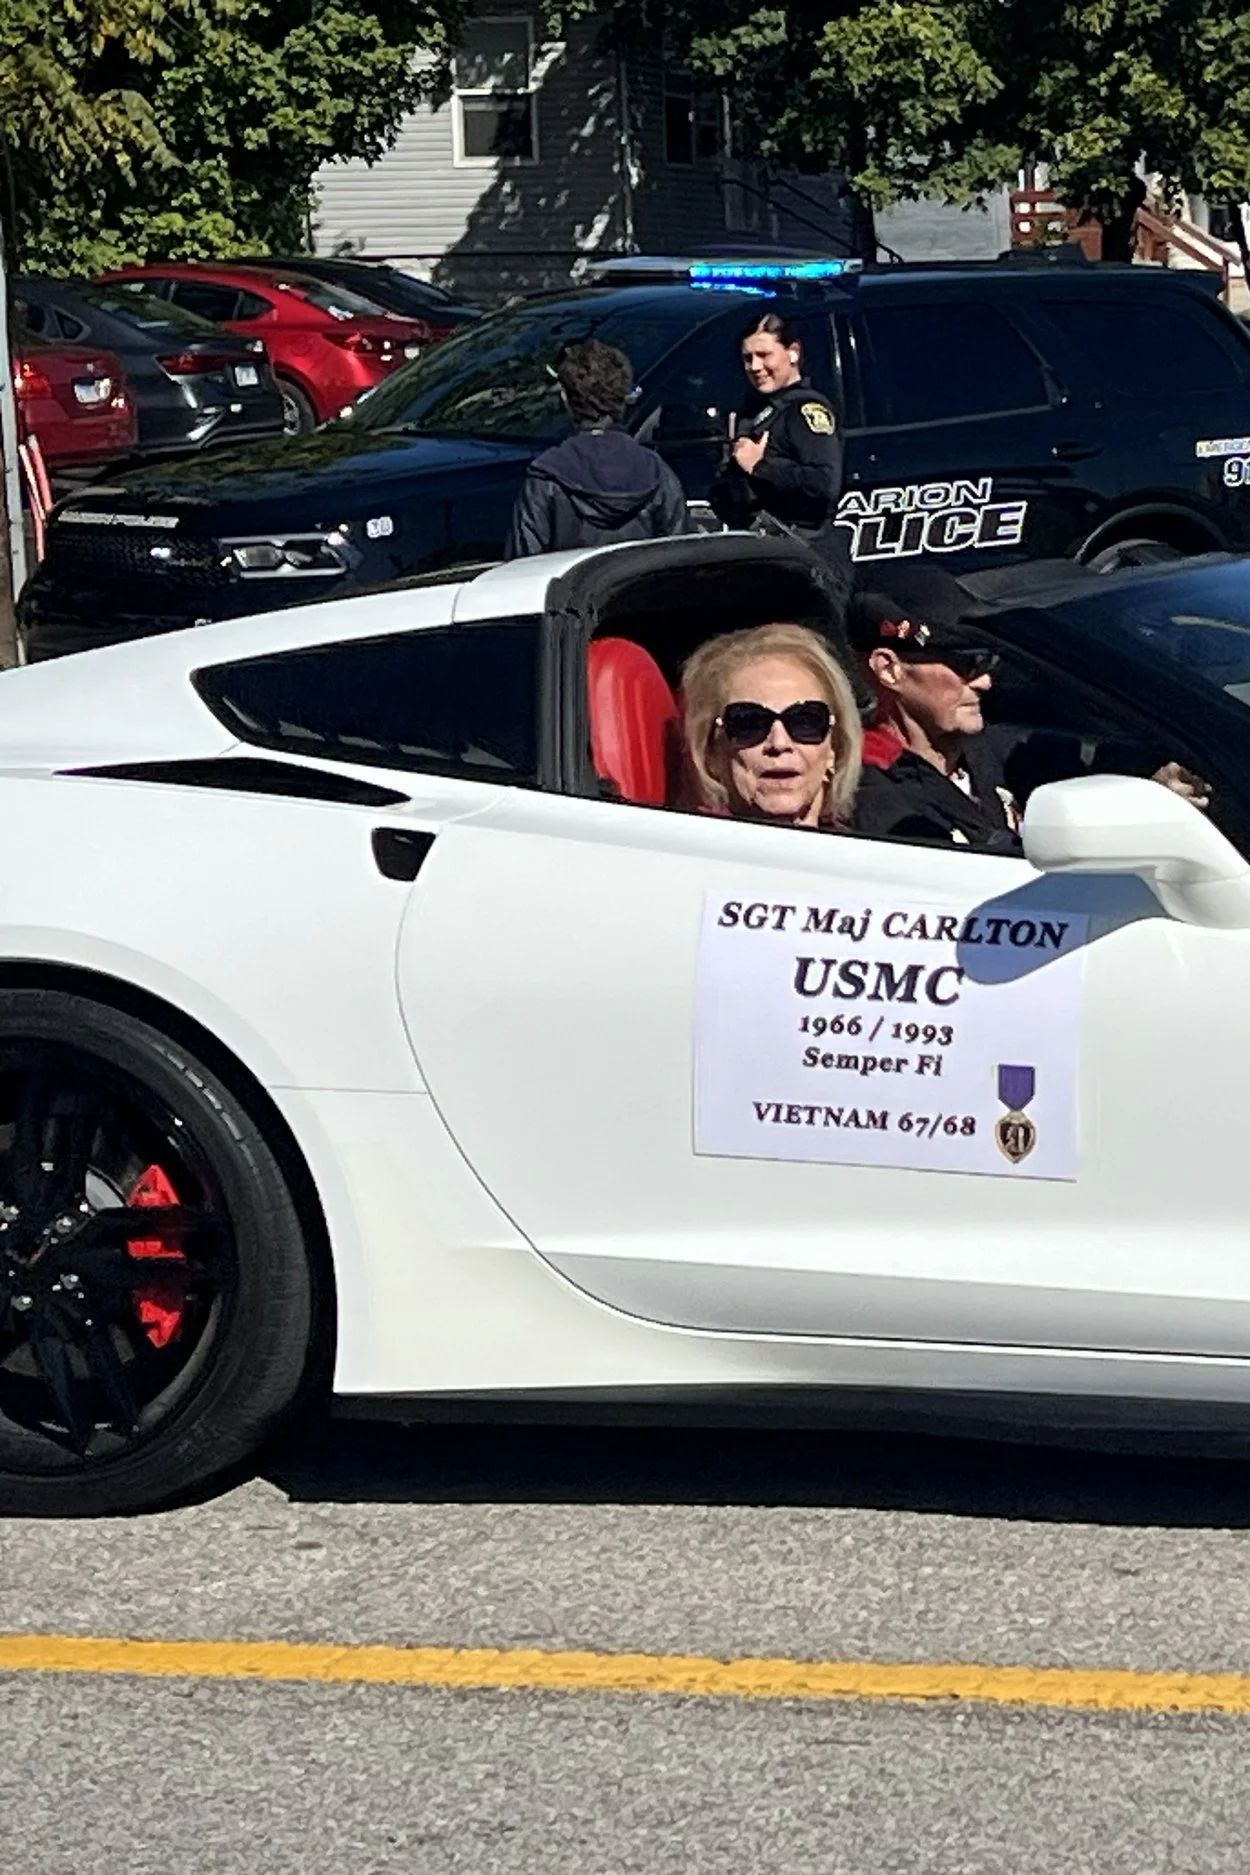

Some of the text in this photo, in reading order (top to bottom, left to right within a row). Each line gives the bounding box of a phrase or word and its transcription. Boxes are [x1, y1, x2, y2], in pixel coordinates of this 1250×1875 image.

[837, 477, 993, 517] ARION
[833, 501, 1028, 562] LICE
[718, 900, 1070, 949] SGT Maj CARLTON
[794, 956, 966, 1006] USMC
[797, 1013, 955, 1047] 1966 / 1993
[802, 1046, 943, 1077] Semper Fi
[752, 1100, 978, 1140] VIETNAM 67/68
